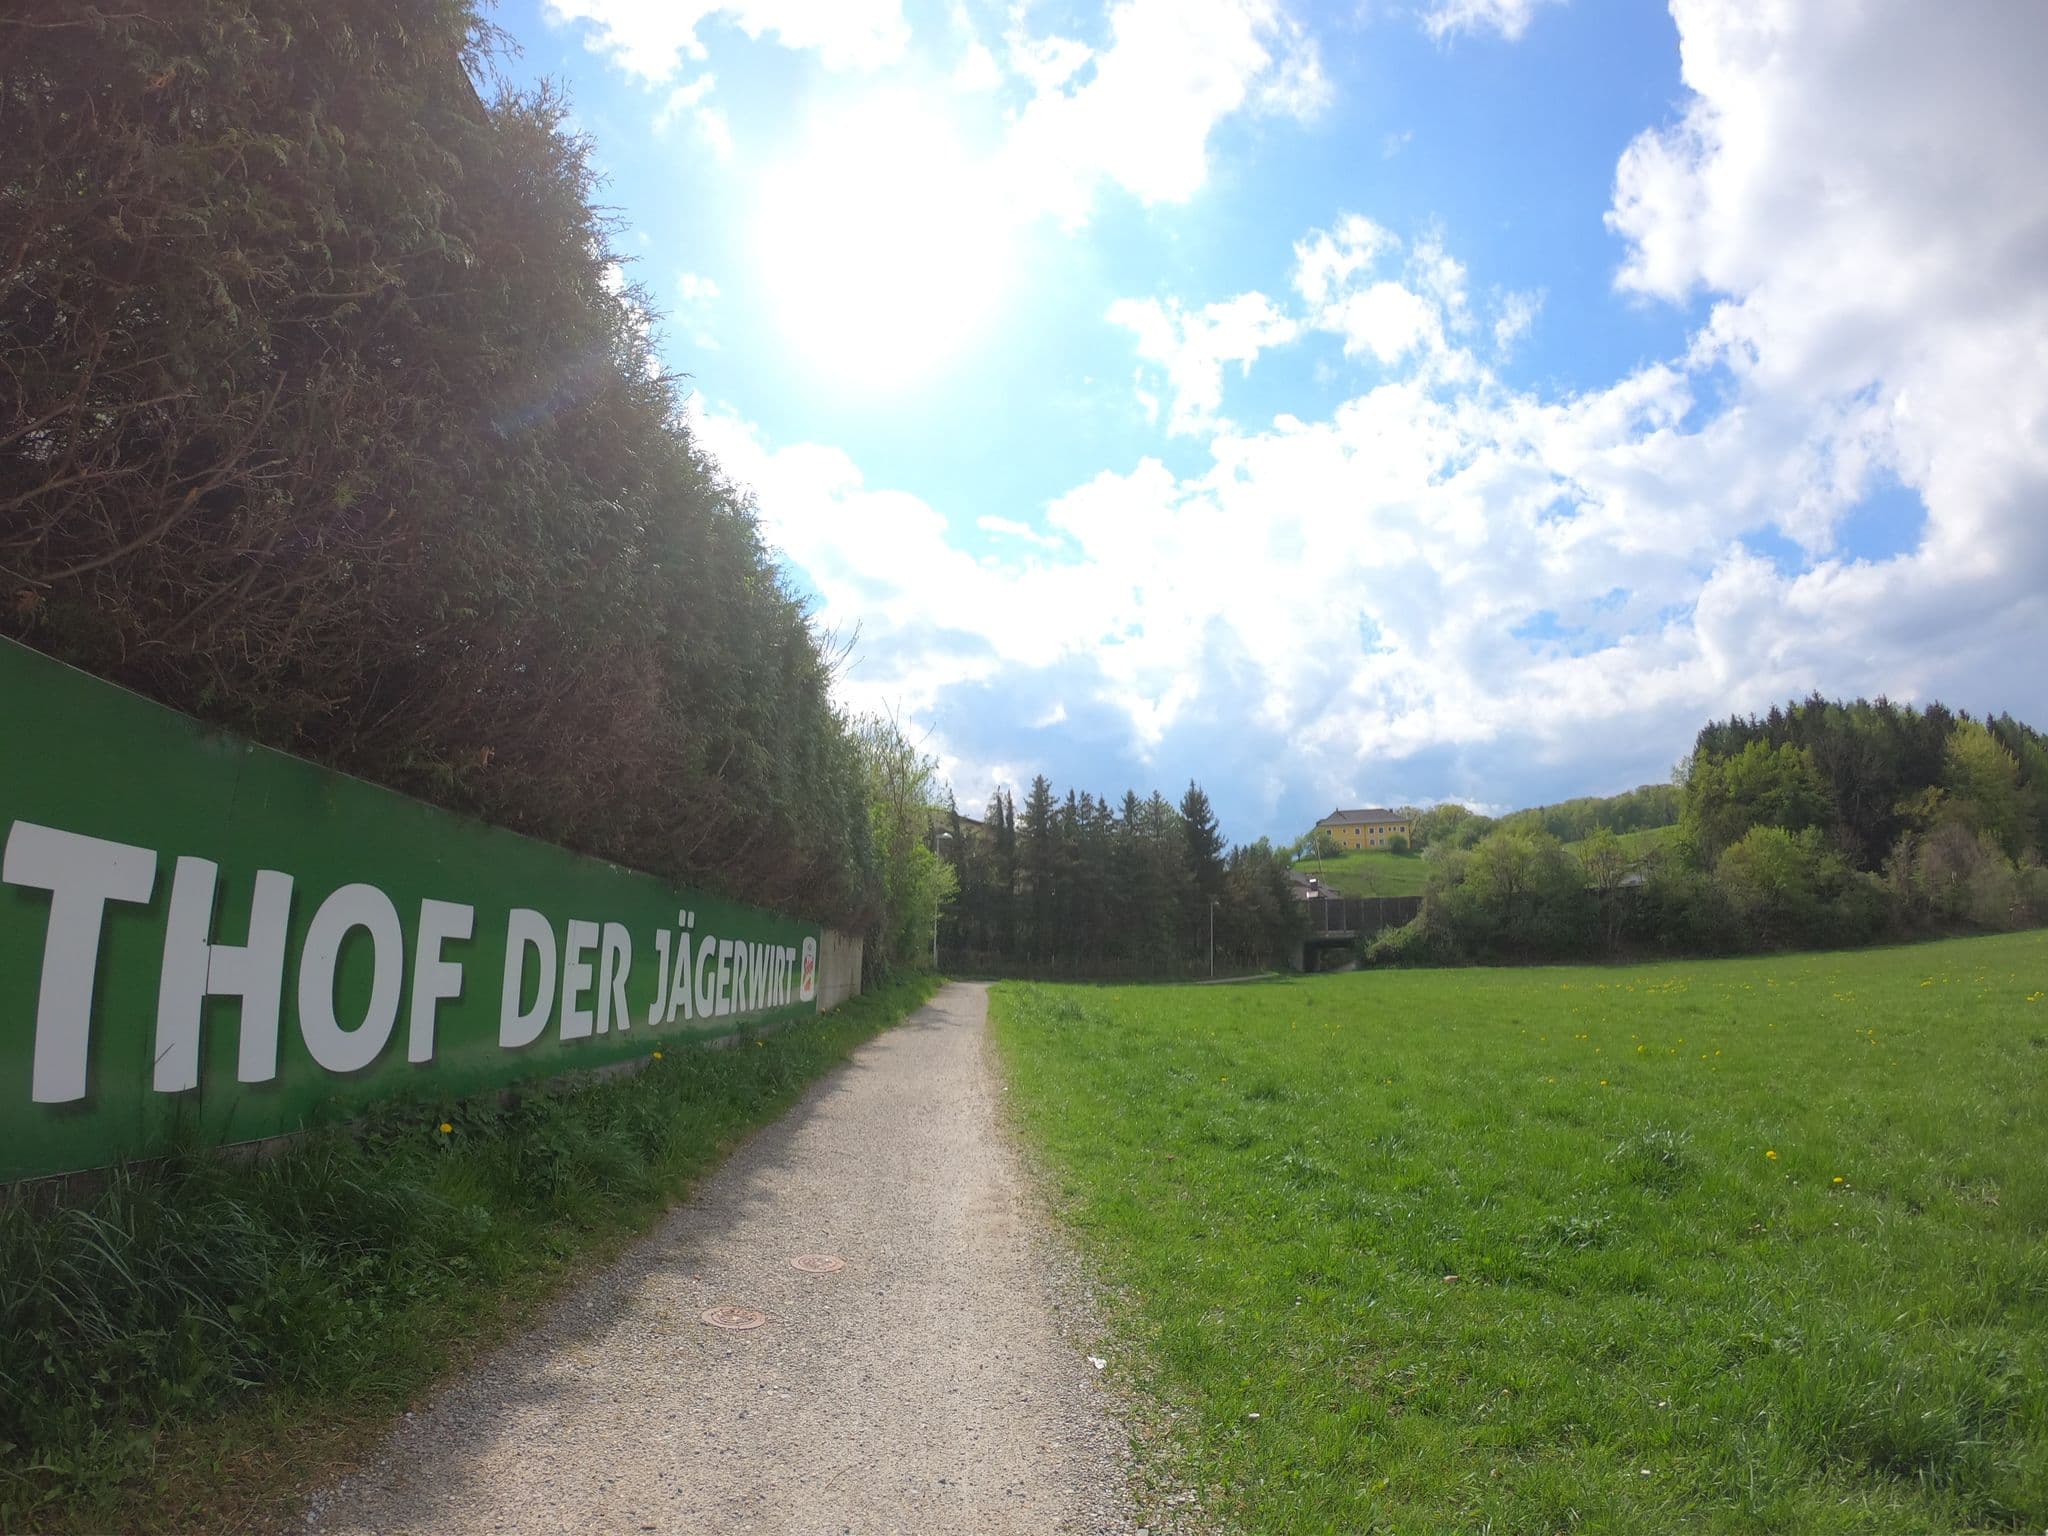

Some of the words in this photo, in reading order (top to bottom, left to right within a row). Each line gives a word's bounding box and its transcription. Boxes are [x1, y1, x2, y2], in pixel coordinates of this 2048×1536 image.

[3, 820, 474, 1103] THOF
[499, 908, 632, 1048] DER
[649, 909, 796, 1026] JÄGERWIRT
